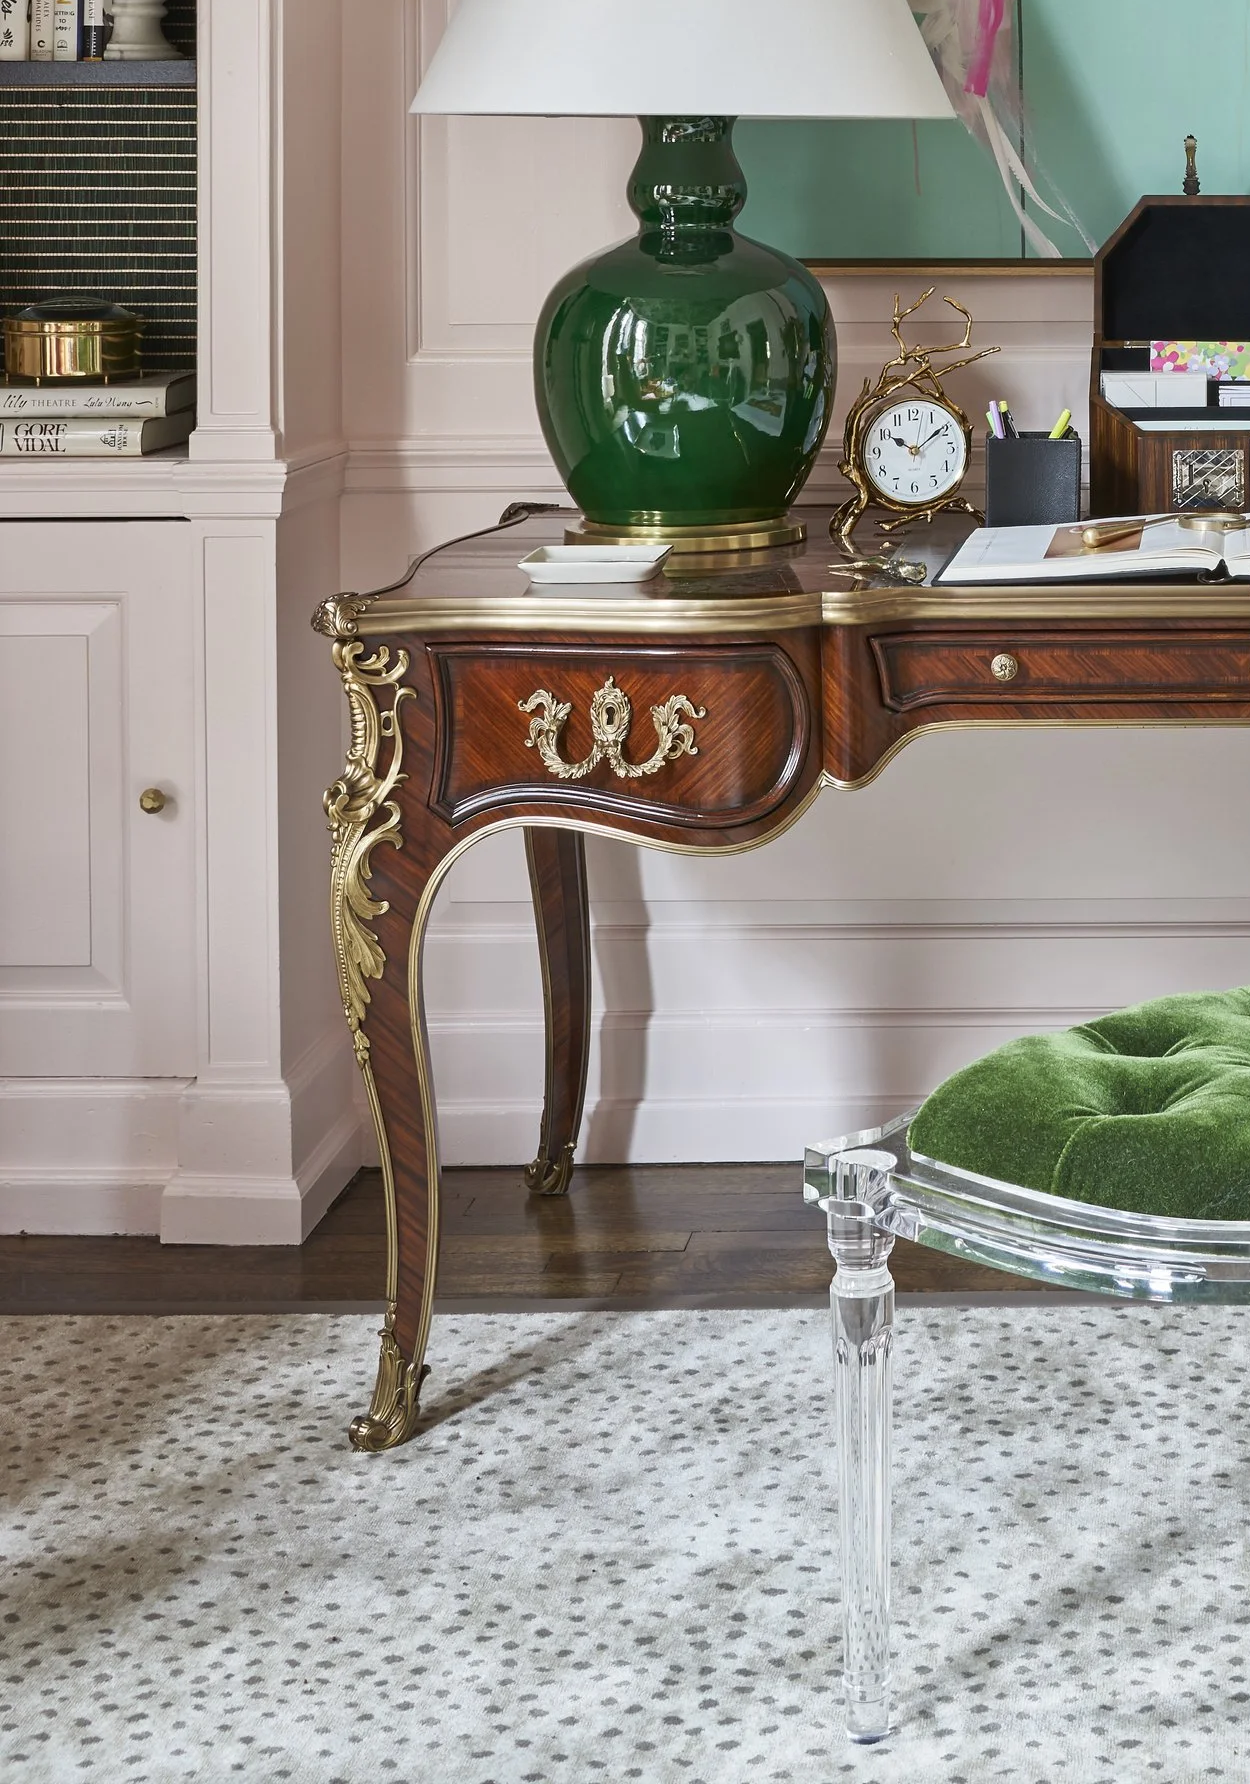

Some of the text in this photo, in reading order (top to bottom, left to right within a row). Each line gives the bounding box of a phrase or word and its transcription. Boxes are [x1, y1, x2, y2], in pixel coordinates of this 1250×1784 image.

[3, 395, 76, 408] lily THEATRE
[908, 408, 919, 421] 12
[14, 423, 68, 436] GORE
[880, 429, 891, 440] 10
[13, 438, 66, 452] VIDAL
